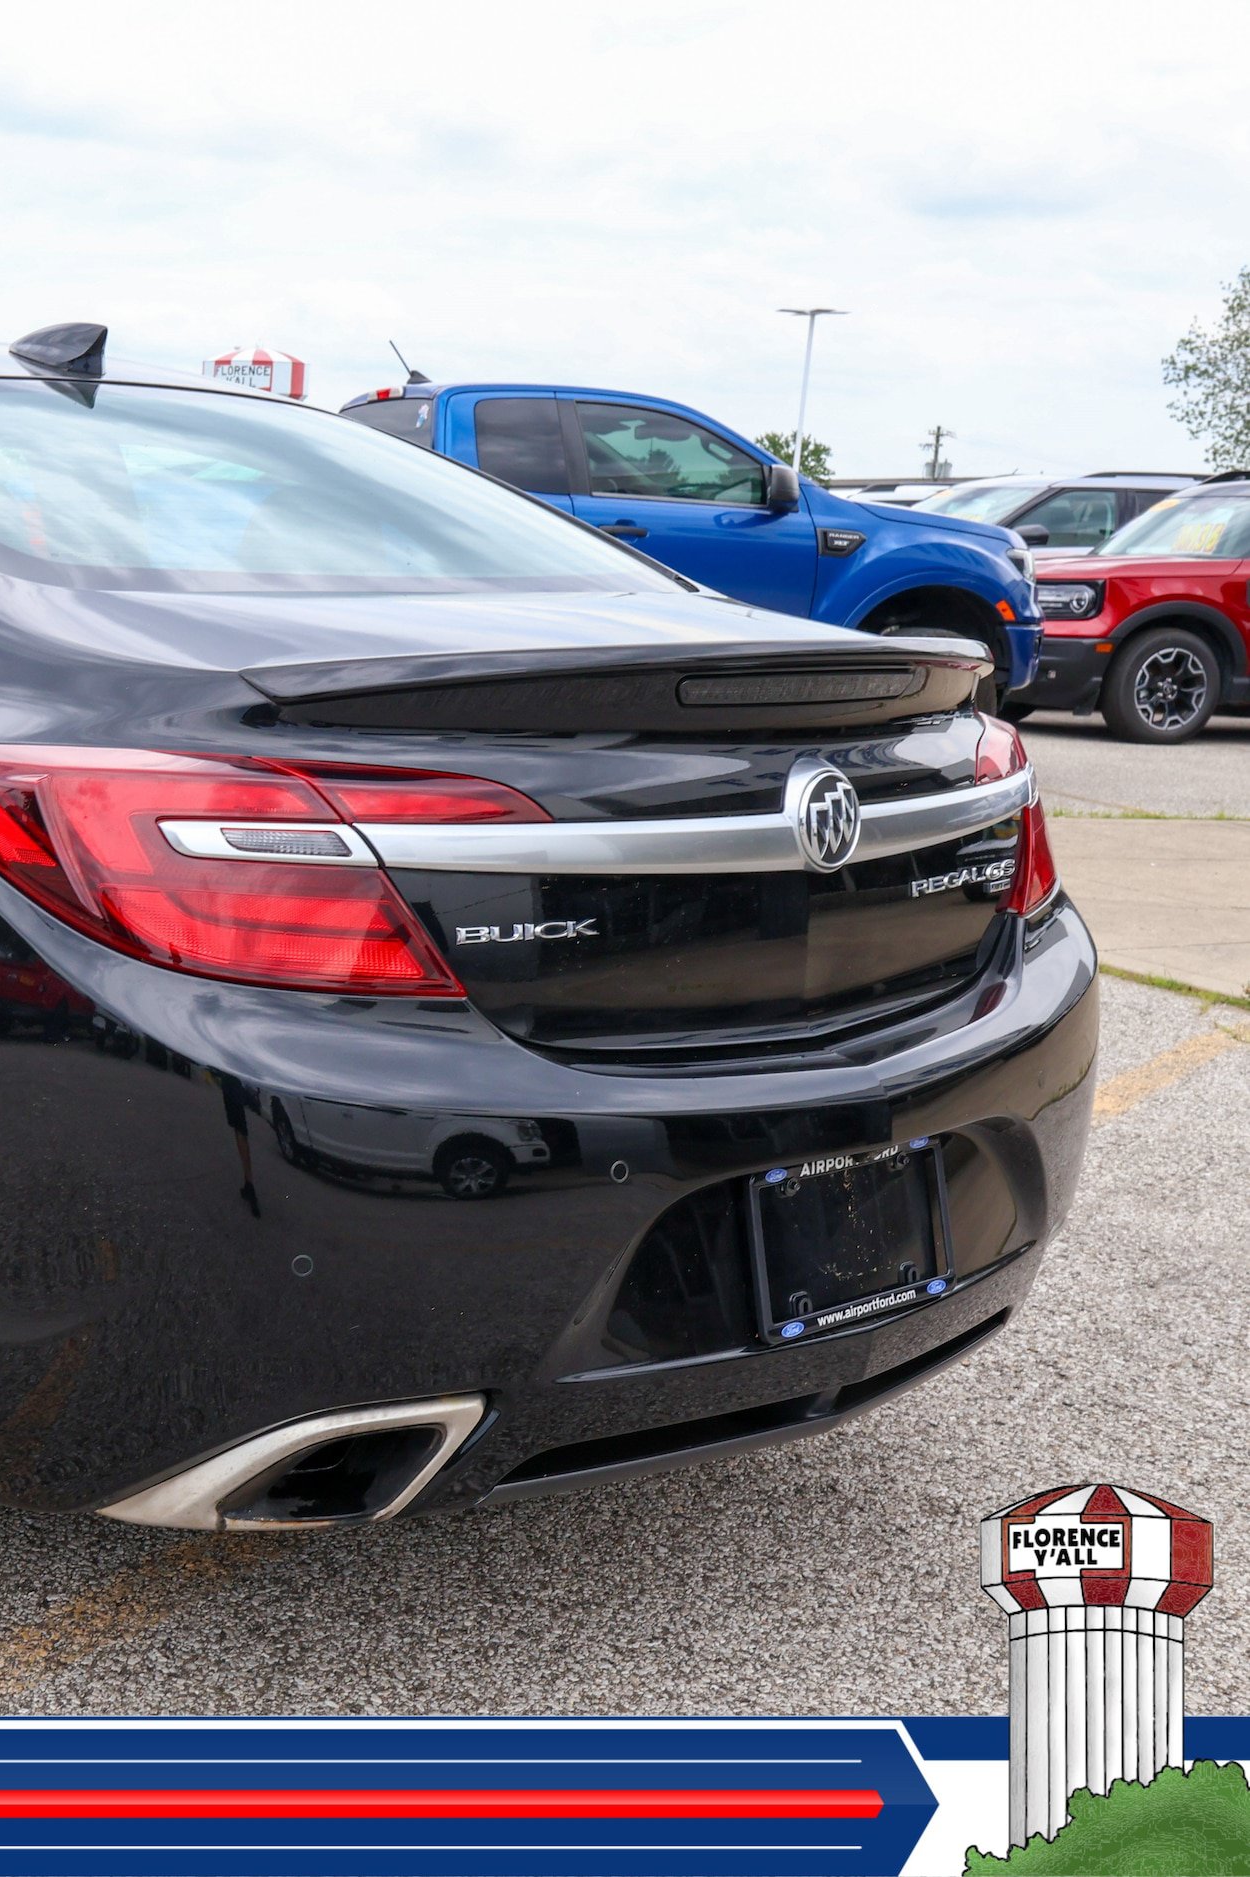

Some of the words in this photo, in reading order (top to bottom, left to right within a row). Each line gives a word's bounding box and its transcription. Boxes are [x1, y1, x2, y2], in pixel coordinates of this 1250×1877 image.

[214, 365, 270, 376] FLORENCE
[455, 918, 600, 945] BUICK
[800, 1155, 860, 1177] AIRPOR
[817, 1289, 916, 1327] www.airportford.com
